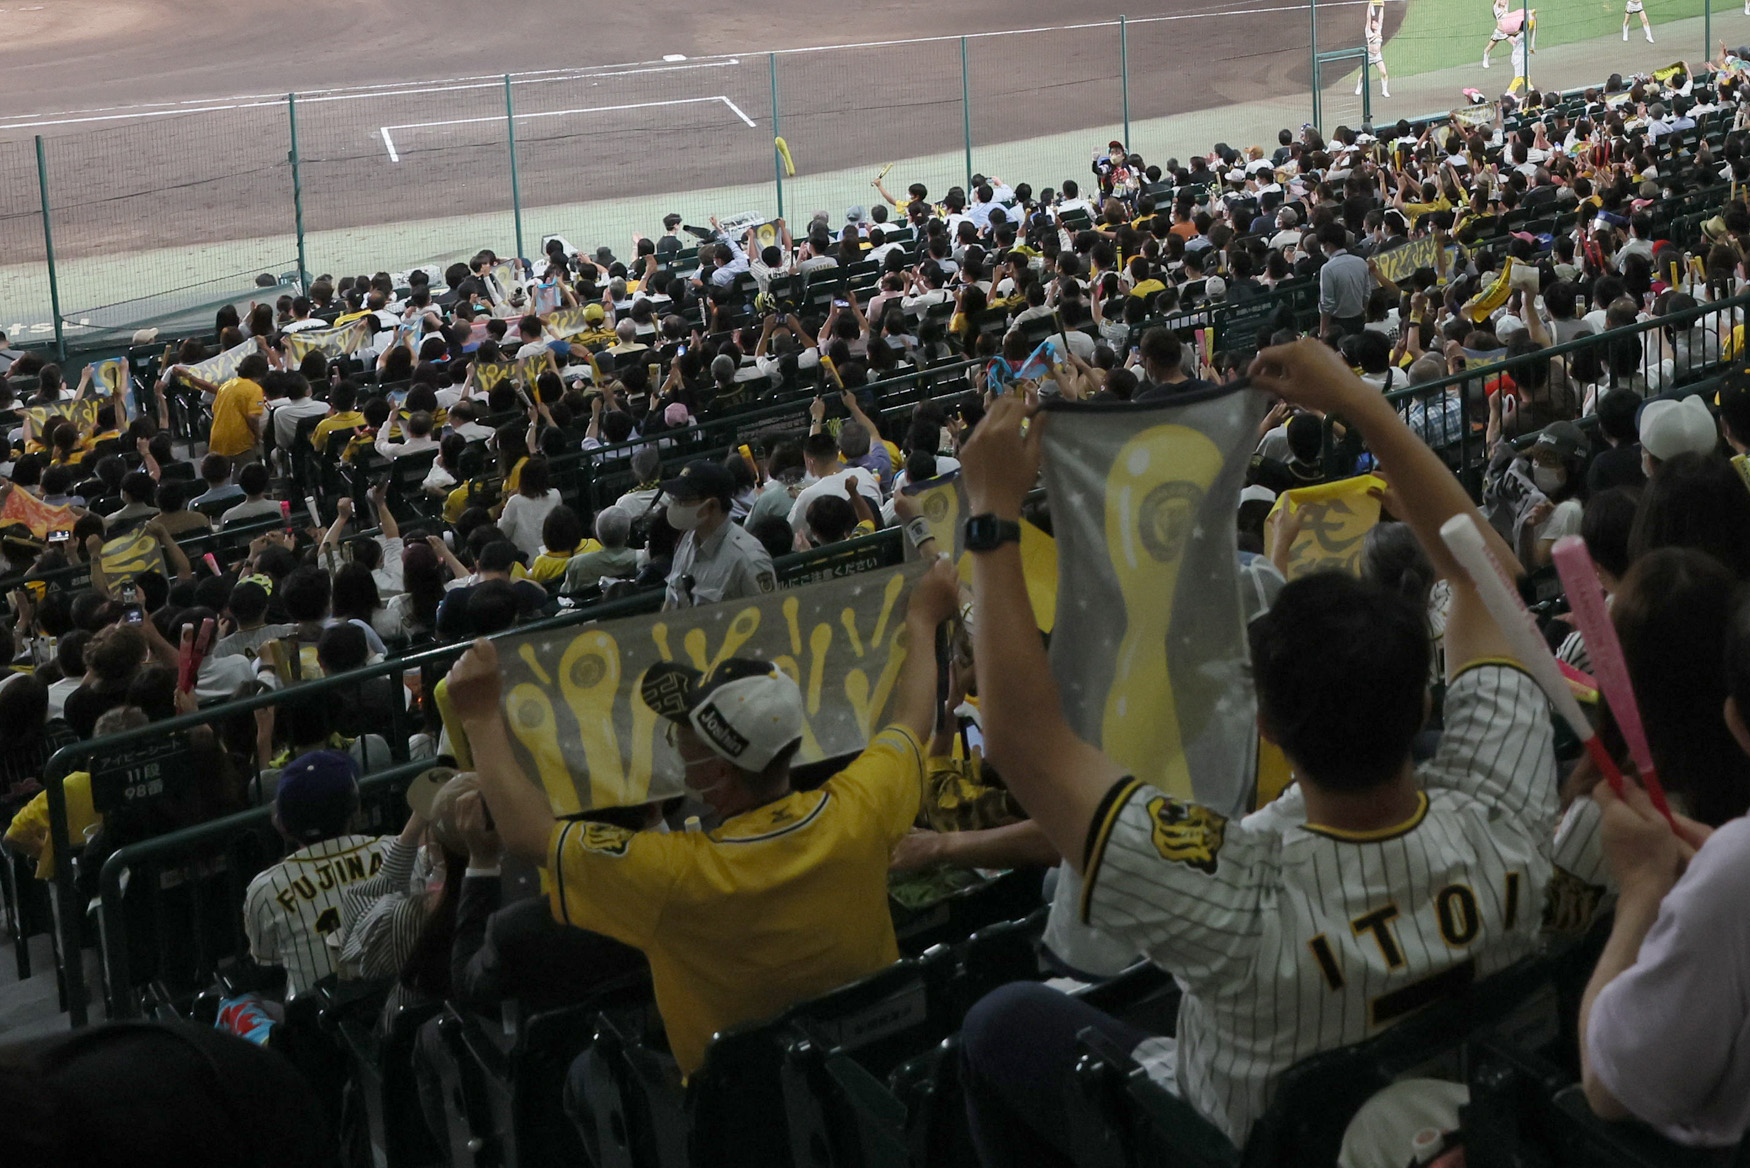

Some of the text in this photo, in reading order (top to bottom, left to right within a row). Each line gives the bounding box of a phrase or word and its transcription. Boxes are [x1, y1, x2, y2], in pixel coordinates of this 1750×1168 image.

[701, 709, 742, 755] Joshin
[124, 778, 163, 800] 98番
[277, 852, 384, 914] FUJINA
[1309, 872, 1520, 992] ITOI
